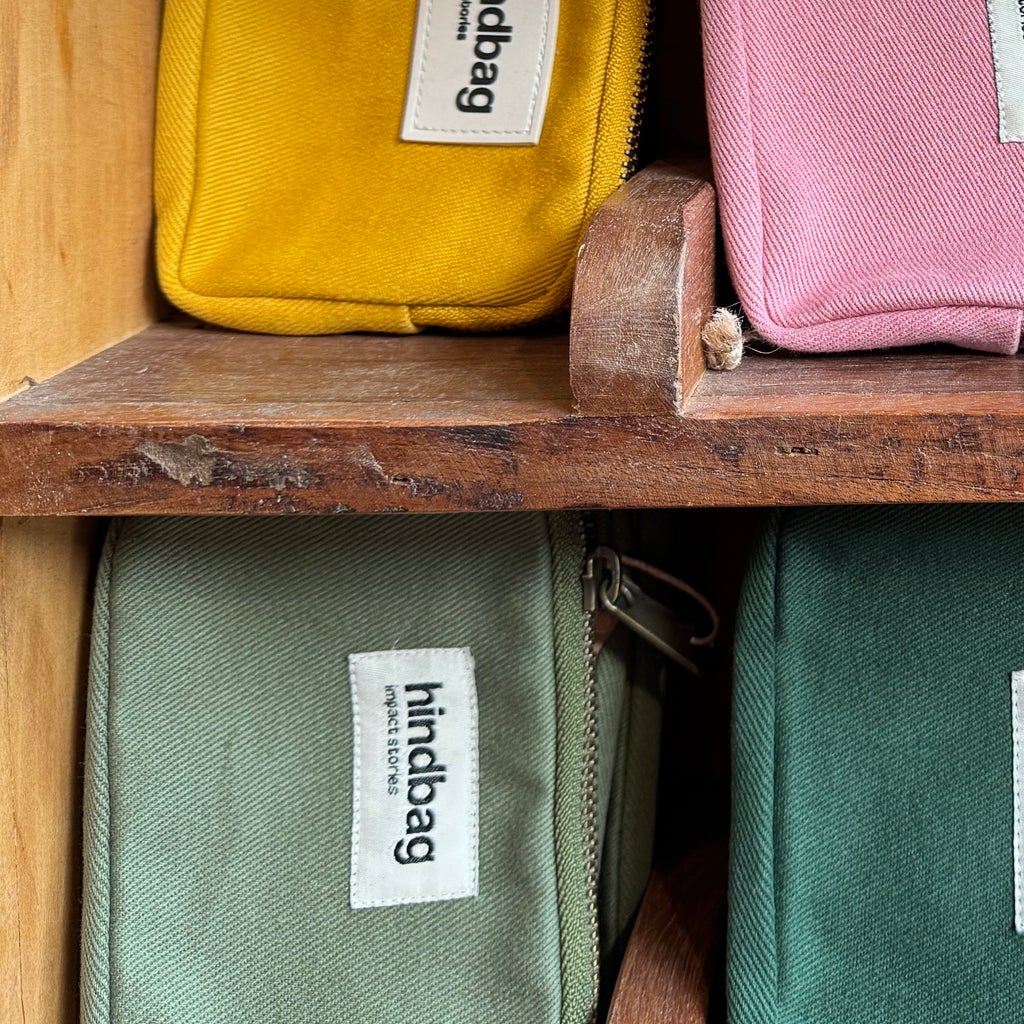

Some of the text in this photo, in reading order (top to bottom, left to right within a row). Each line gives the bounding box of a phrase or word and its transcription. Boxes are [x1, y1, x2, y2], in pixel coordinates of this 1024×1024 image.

[384, 684, 400, 796] impact stories
[393, 681, 448, 866] hindbag
